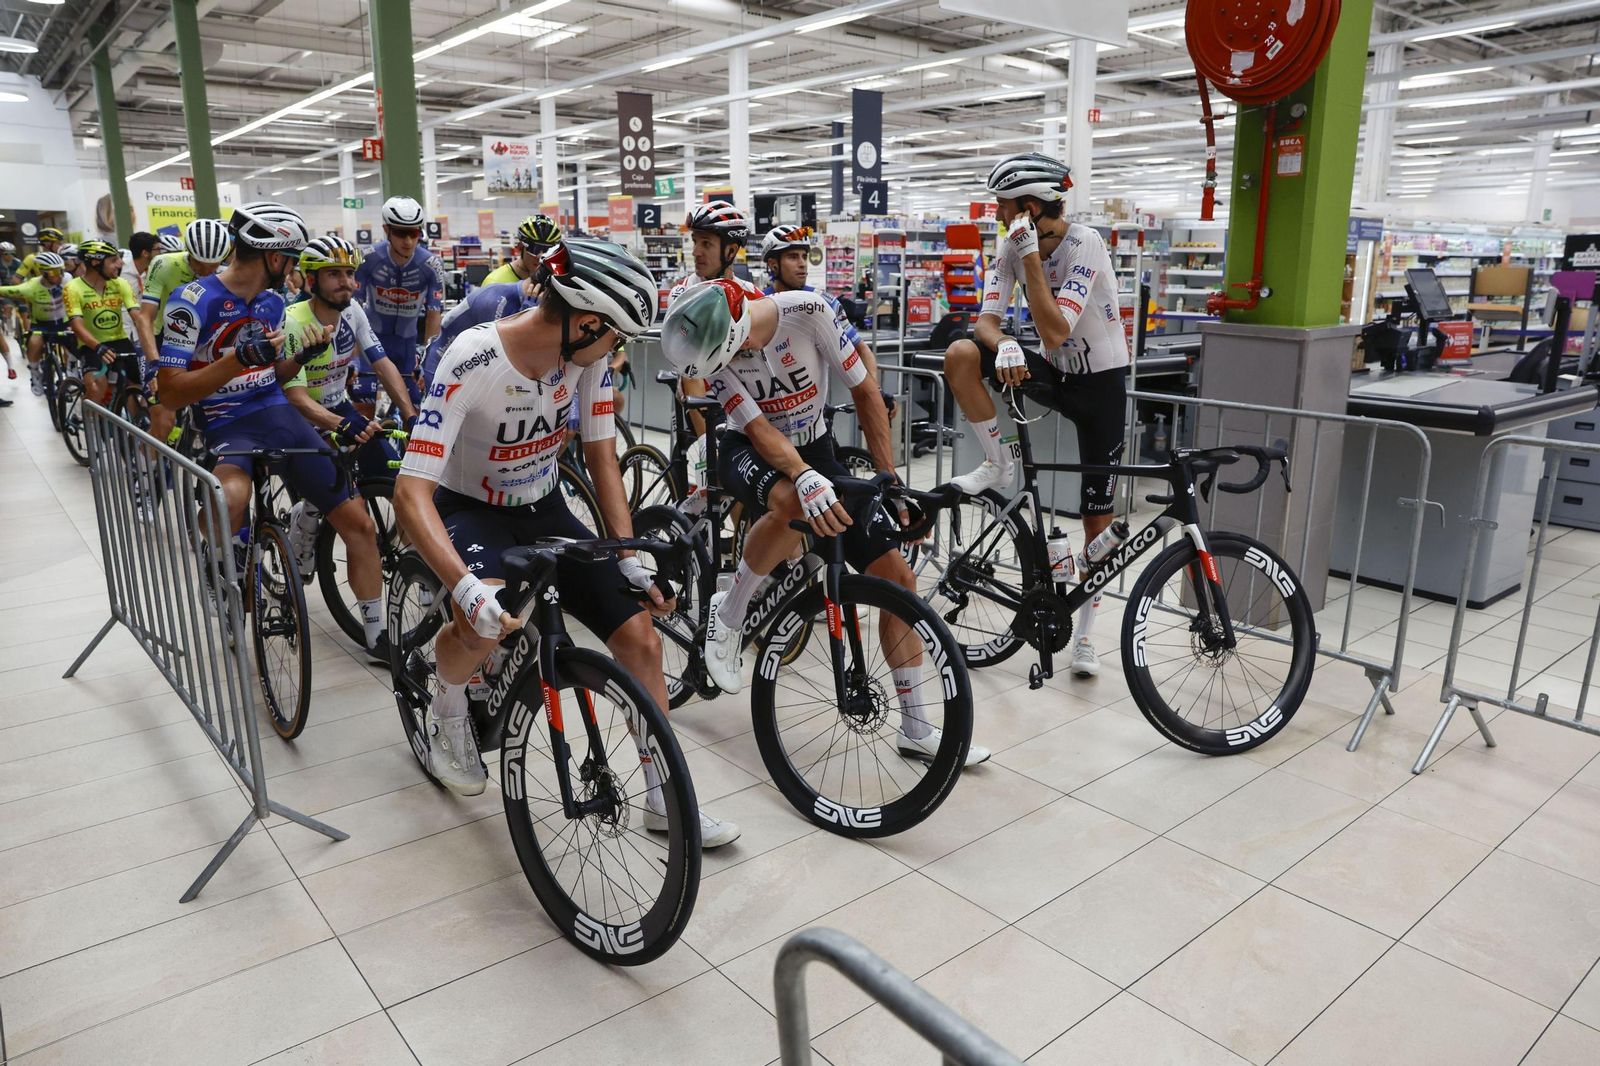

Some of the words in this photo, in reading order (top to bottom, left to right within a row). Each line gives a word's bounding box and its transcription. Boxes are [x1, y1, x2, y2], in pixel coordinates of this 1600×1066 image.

[146, 191, 196, 202] Pensan
[868, 190, 880, 208] 4
[644, 209, 654, 224] 2
[251, 239, 301, 248] SPECIALIZED
[1063, 280, 1088, 298] ADQ
[782, 301, 825, 316] presight
[1057, 298, 1082, 314] mirates
[452, 347, 499, 379] presight
[743, 366, 812, 401] UAE
[761, 388, 816, 414] mirates
[496, 402, 573, 445] UAE
[408, 441, 443, 457] mirates
[491, 431, 566, 461] Emirates
[802, 480, 821, 496] UAE
[1083, 526, 1157, 594] COLNAGO
[465, 593, 482, 620] UAE
[742, 564, 804, 636] COLNAGO
[707, 604, 719, 641] nimbl
[487, 634, 529, 717] COLNAGO
[543, 687, 553, 721] Emirates
